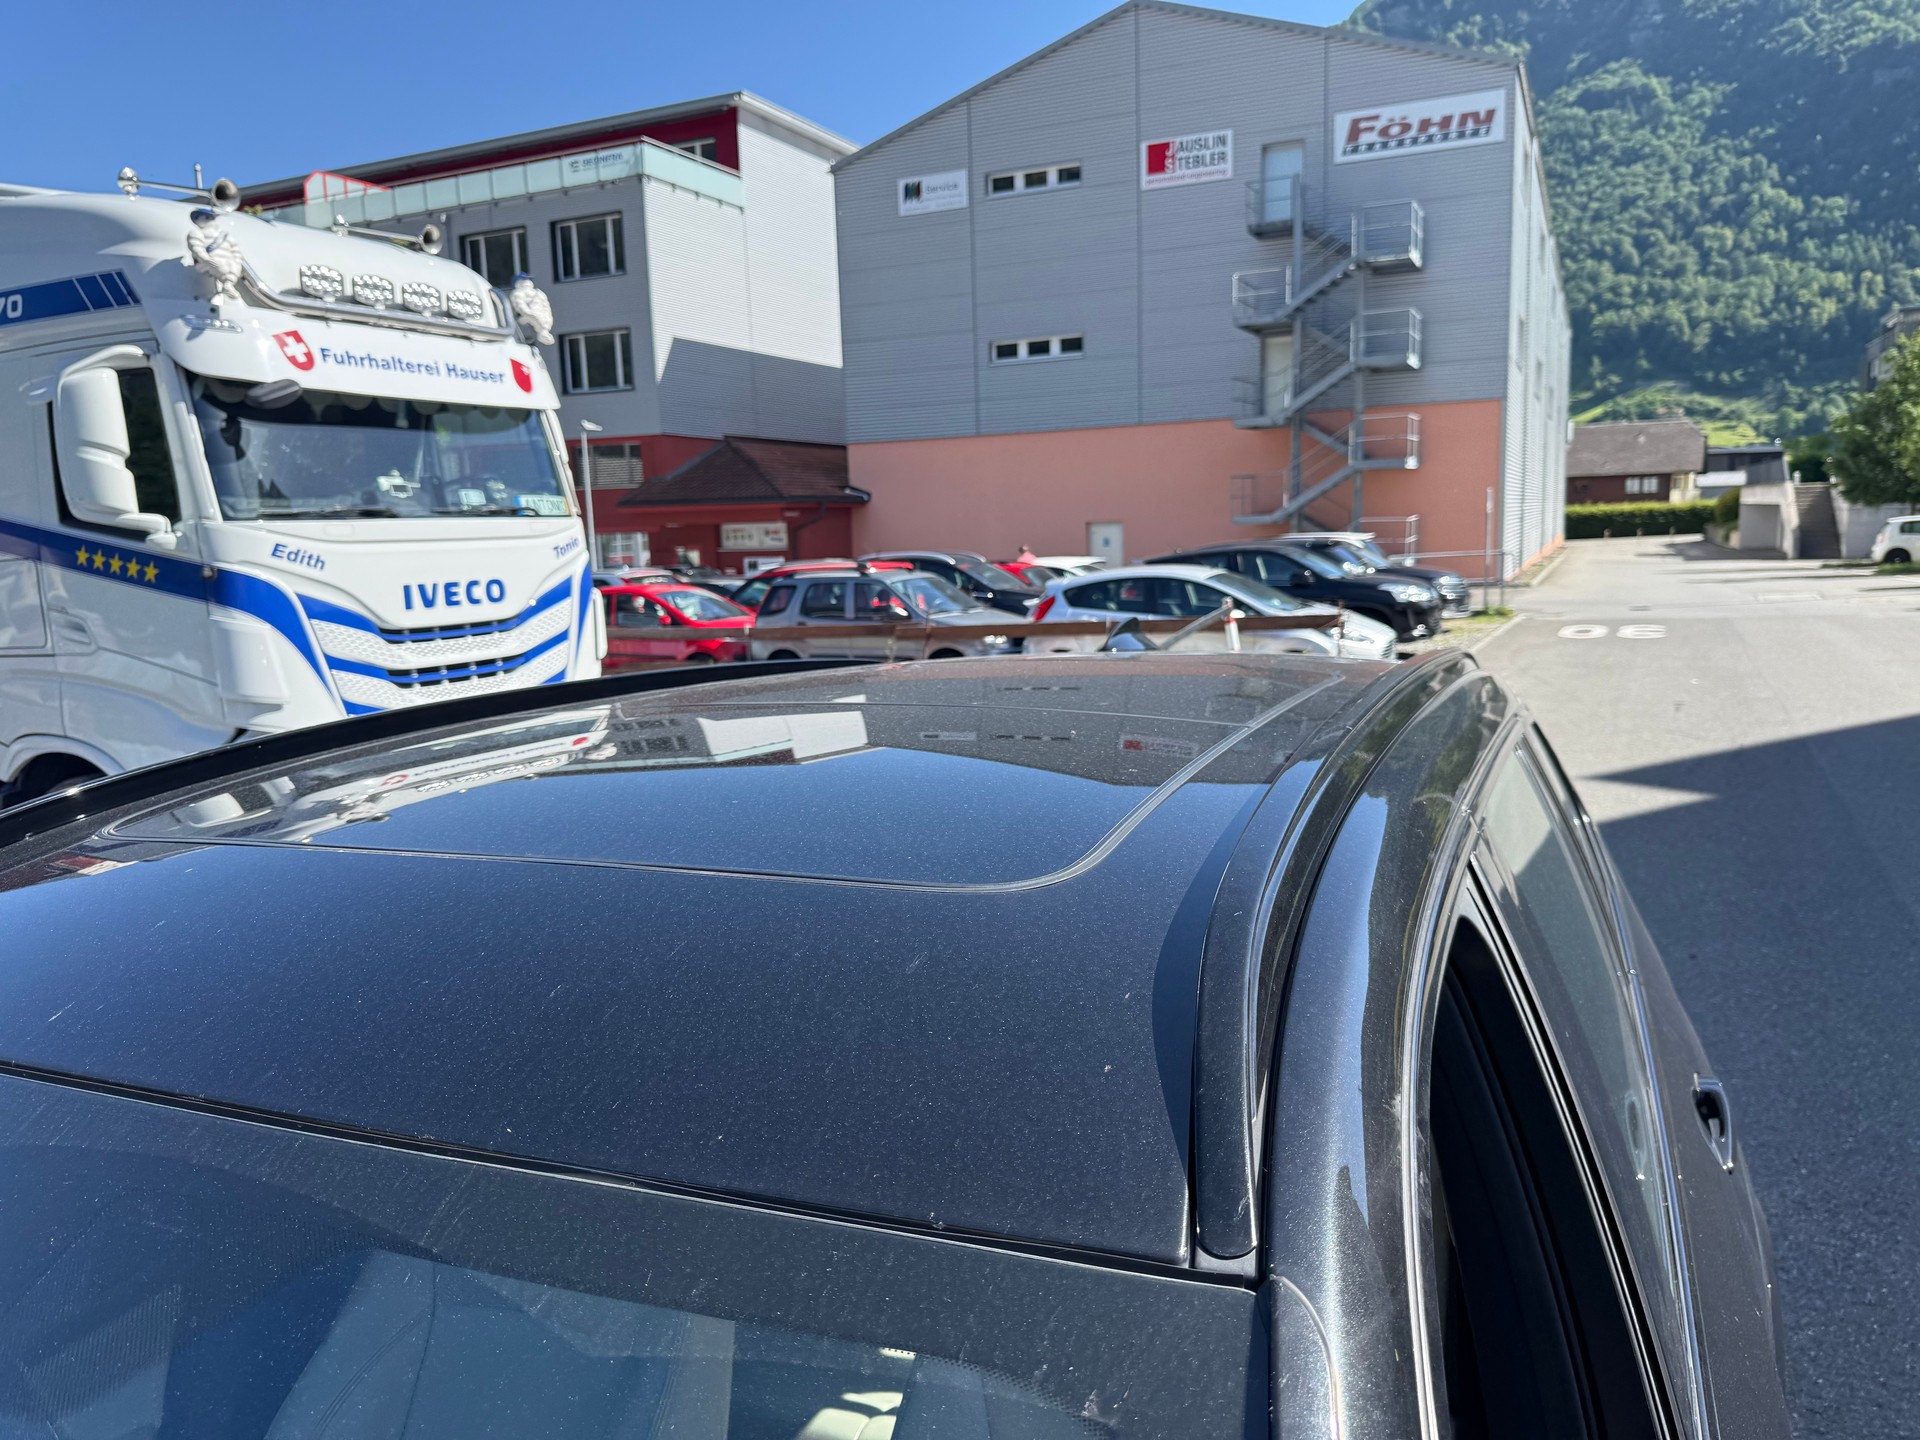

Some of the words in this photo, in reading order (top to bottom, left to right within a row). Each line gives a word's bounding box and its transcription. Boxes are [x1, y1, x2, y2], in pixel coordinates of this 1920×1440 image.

[1344, 126, 1491, 156] TRANSPORTE
[1346, 108, 1496, 145] FÖHN
[1165, 151, 1227, 174] STEBLER
[320, 347, 440, 376] Fuhrhalterei
[446, 362, 505, 384] Hauser
[271, 543, 326, 571] Edith
[403, 579, 506, 610] IVECO
